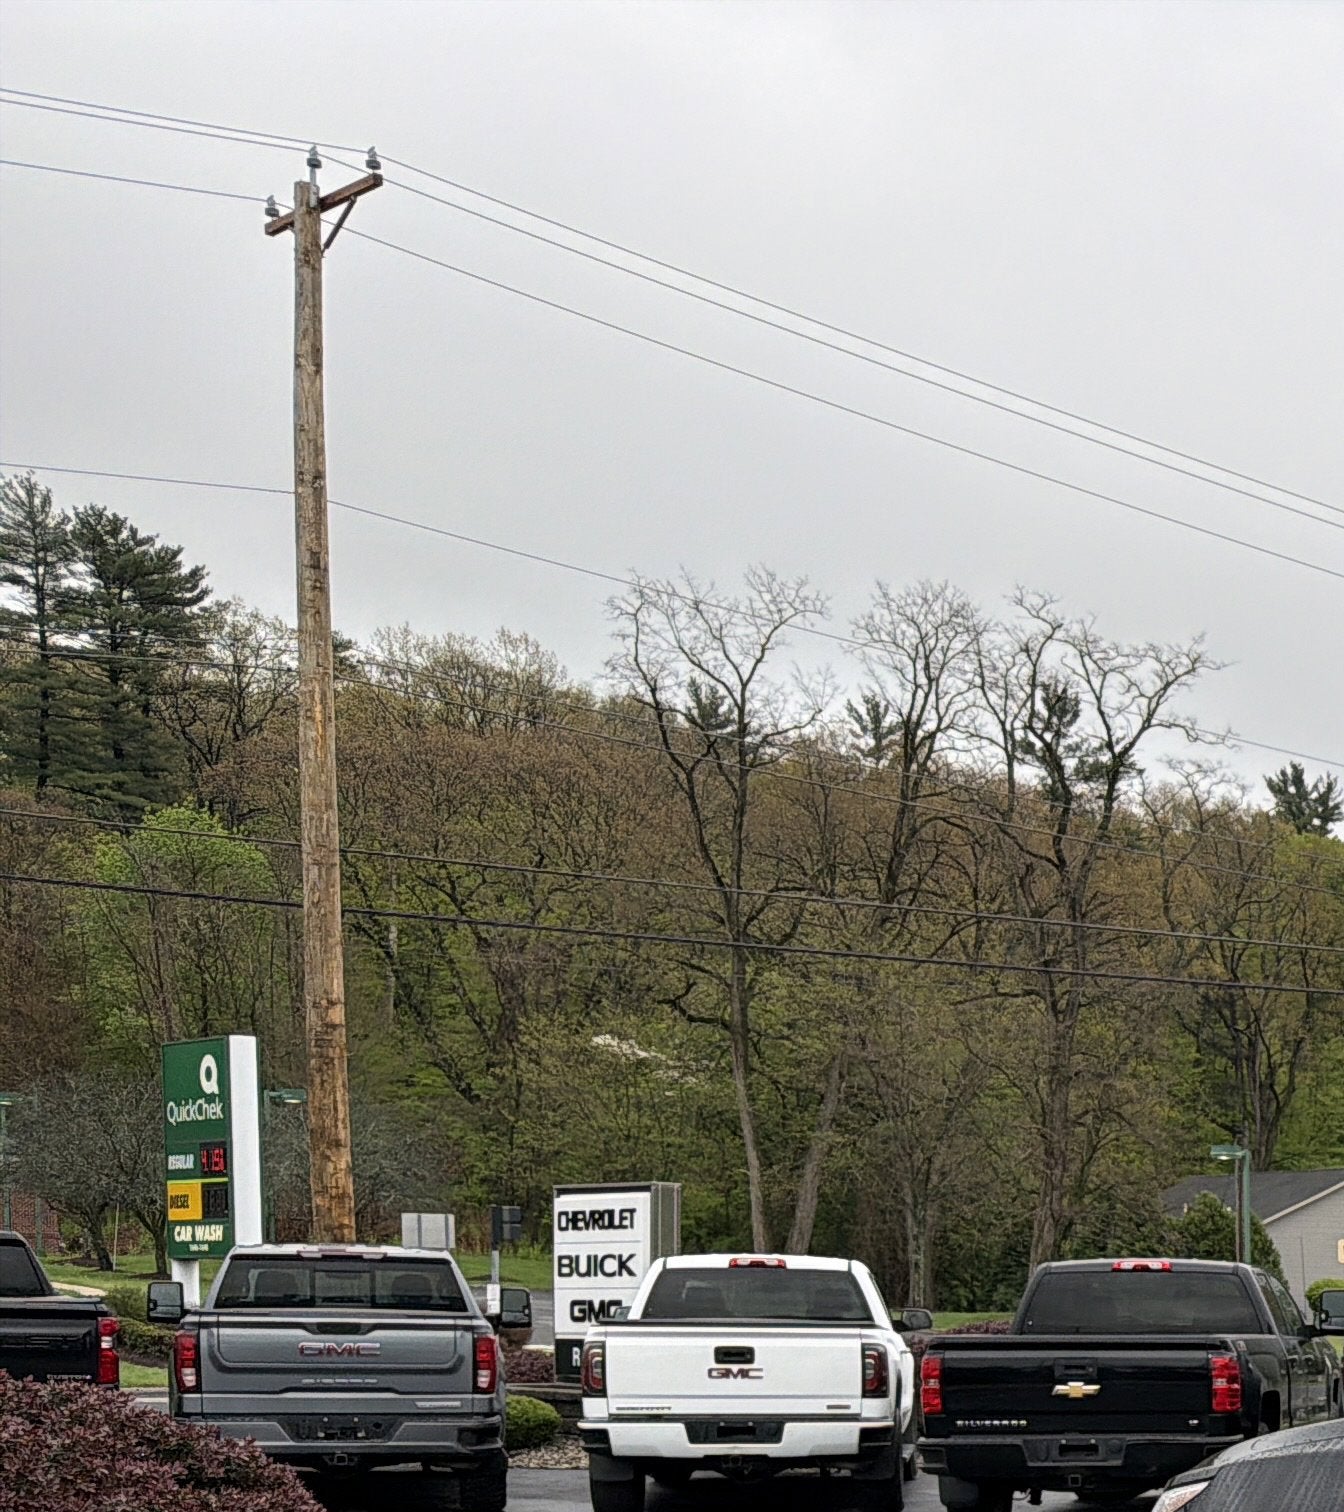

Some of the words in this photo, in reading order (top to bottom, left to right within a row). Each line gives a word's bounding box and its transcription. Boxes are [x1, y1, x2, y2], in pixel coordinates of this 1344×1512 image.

[200, 1054, 219, 1094] Q
[167, 1096, 224, 1126] QuickChek
[167, 1154, 194, 1170] REGULAR
[169, 1194, 190, 1209] DIESEL
[557, 1208, 637, 1231] CHEVROLET
[174, 1225, 193, 1242] CAR
[194, 1224, 224, 1242] WASH
[557, 1253, 637, 1278] BUICK
[298, 1342, 381, 1357] GMC
[707, 1367, 764, 1380] GMC
[955, 1419, 1028, 1428] SILVERADO
